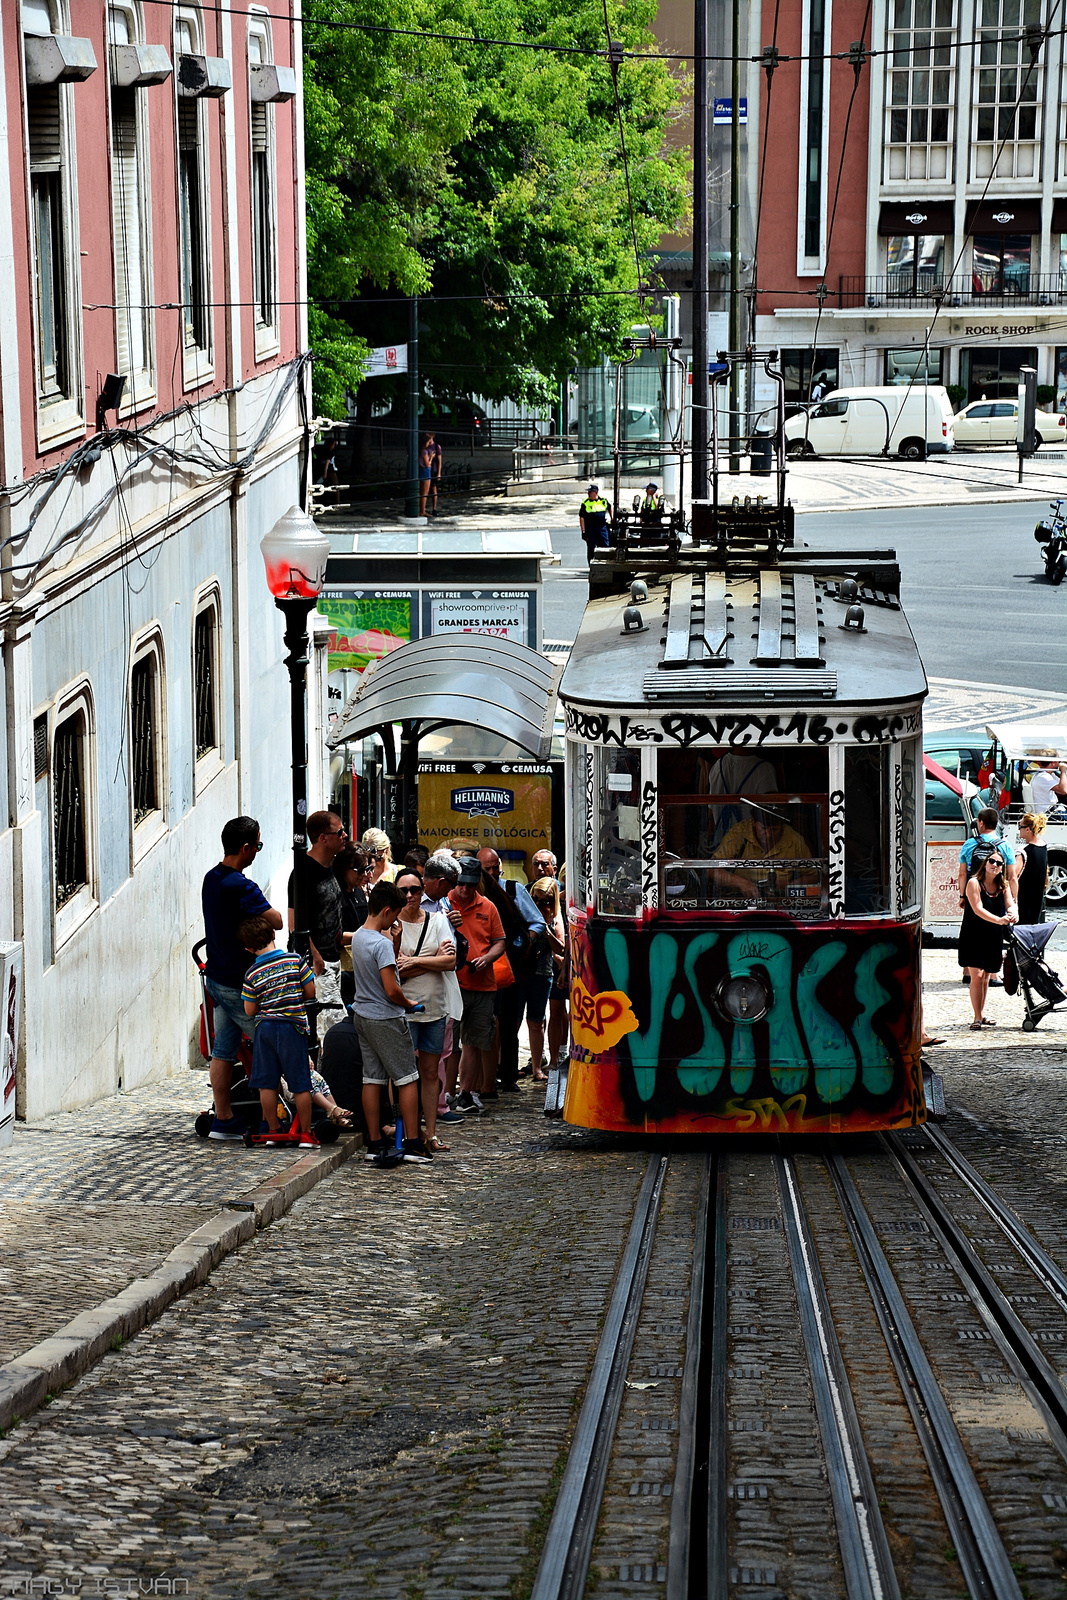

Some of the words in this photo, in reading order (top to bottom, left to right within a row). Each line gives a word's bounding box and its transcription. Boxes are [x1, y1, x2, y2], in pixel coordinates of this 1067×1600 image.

[965, 326, 999, 335] ROCK
[1002, 326, 1034, 335] SHOP
[327, 591, 343, 599] FREE
[428, 591, 445, 599] WiFi
[445, 591, 461, 599] FREE
[481, 618, 519, 626] MARCAS
[434, 764, 456, 773] FREE
[512, 765, 553, 773] CEMUSA
[454, 790, 511, 805] HELLMANN'S
[419, 828, 479, 837] MAIONESE
[483, 826, 547, 838] BIOLÓGICA
